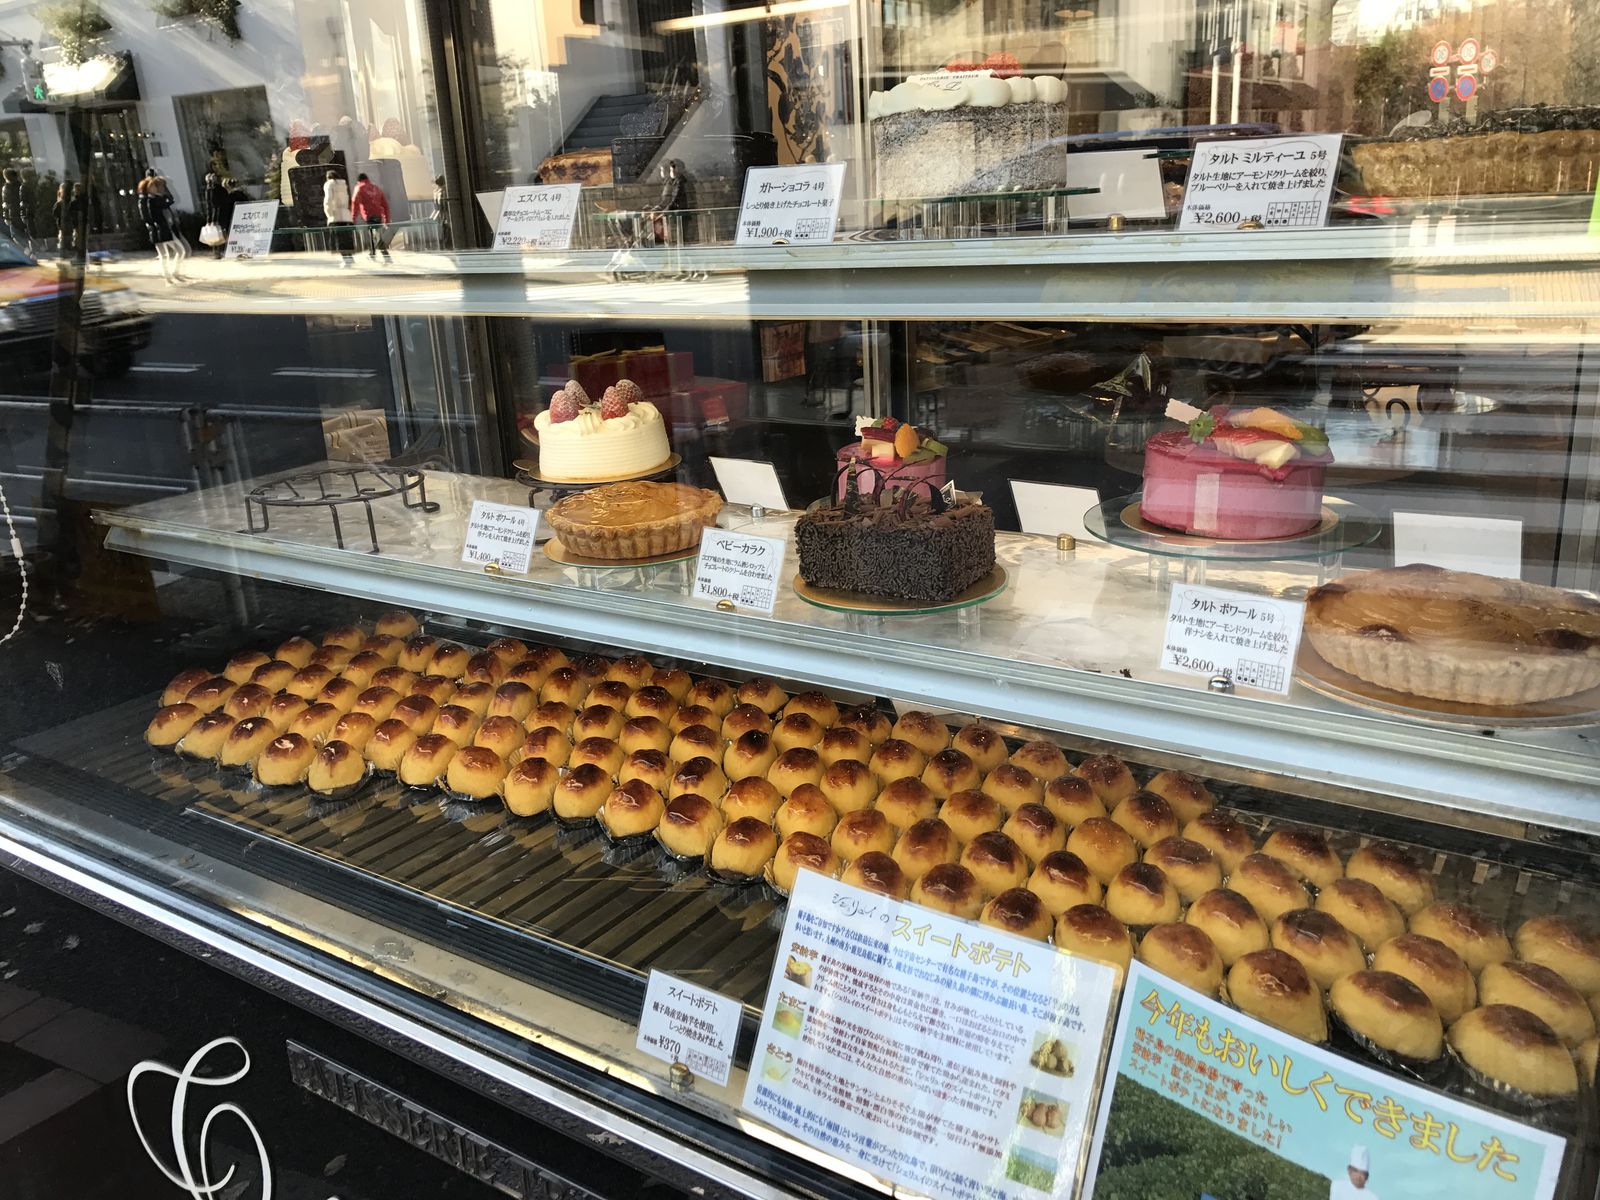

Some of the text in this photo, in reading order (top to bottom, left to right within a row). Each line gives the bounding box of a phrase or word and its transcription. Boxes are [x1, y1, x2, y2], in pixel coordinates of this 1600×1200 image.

[1209, 150, 1327, 165] タルト ミルティーユ 5号
[759, 181, 825, 194] ガトーショコラ 4号
[1190, 179, 1326, 192] ブルーベリーを入れて焼き上げました
[517, 193, 548, 203] エスパス
[480, 511, 495, 521] タルト
[716, 539, 766, 556] ベビーカラク
[1191, 598, 1276, 624] タルト ポワール 5号
[1184, 627, 1288, 655] 洋ナシを入れて焼き上げました
[891, 914, 1032, 979] スイートポテト
[667, 986, 719, 1015] スイートポテト
[652, 1001, 718, 1036] 種子島産安納芋を使用し、
[658, 1034, 681, 1055] ¥370
[669, 1020, 724, 1051] しっとり焼きあげました
[1139, 988, 1520, 1182] 今年もおいしくできました
